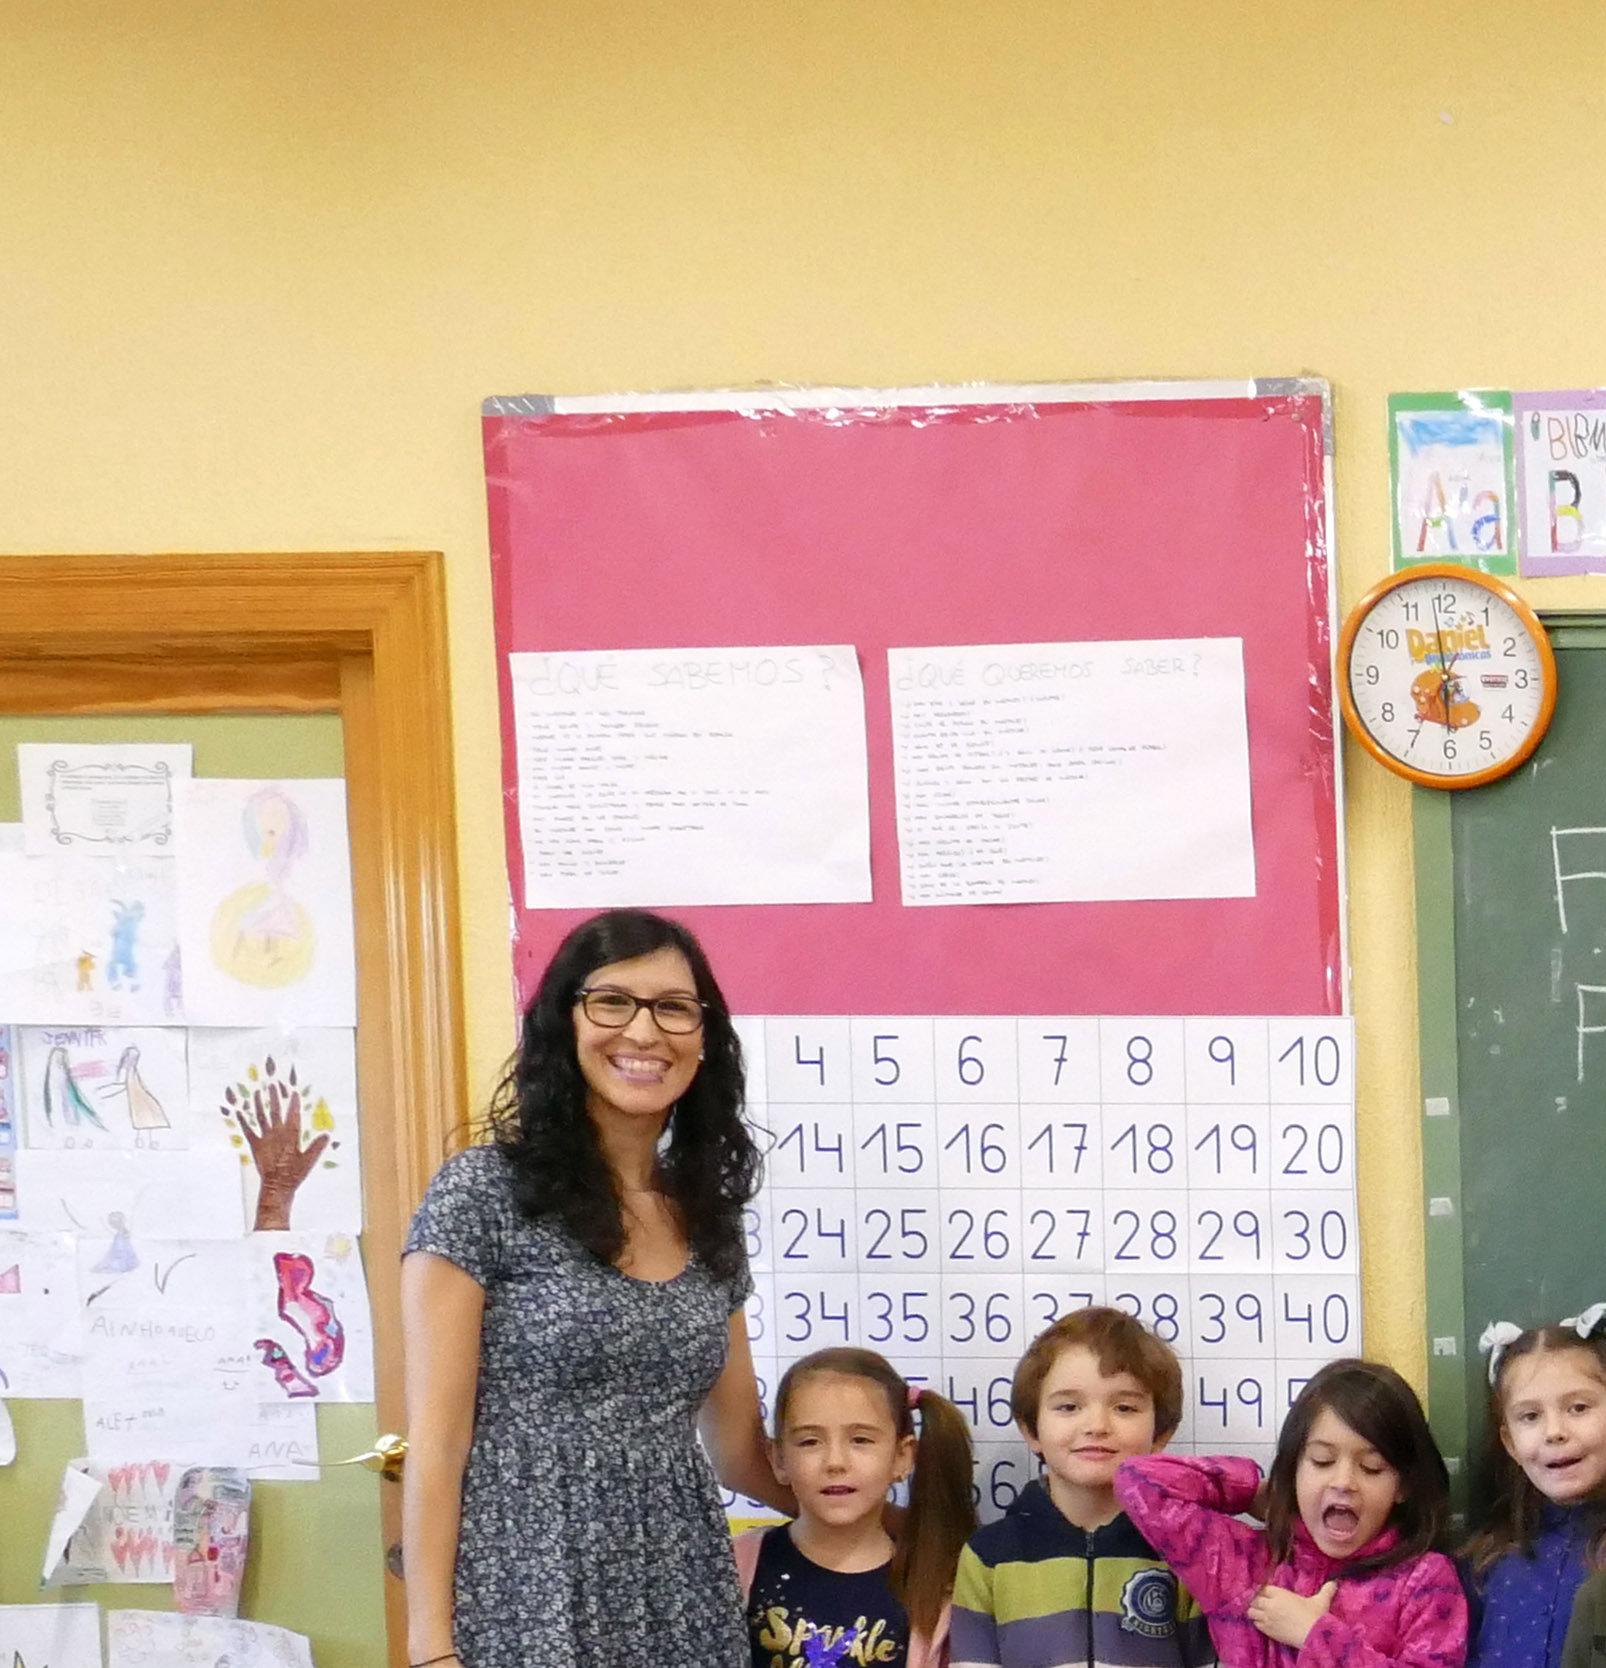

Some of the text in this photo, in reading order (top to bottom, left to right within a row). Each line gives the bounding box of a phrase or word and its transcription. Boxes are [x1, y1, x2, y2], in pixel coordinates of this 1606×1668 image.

[1402, 602, 1419, 622] 11
[1433, 594, 1457, 614] 12
[1482, 607, 1490, 627] 1
[1377, 628, 1400, 650] 10
[1406, 624, 1491, 663] Daniel
[1503, 637, 1517, 658] 2
[1366, 665, 1380, 686] 9
[1514, 669, 1529, 690] 3
[1381, 702, 1395, 723] 8
[1501, 704, 1515, 723] 4
[1407, 729, 1420, 749] 7
[1443, 739, 1457, 760] 6
[1479, 730, 1493, 750] 5
[795, 1034, 826, 1086] 4
[872, 1034, 901, 1086] 5
[957, 1034, 985, 1086] 6
[1042, 1034, 1068, 1086] 7
[1126, 1034, 1154, 1086] 8
[1208, 1034, 1237, 1086] 9
[1279, 1034, 1341, 1086] 10
[777, 1122, 844, 1174] 14
[861, 1122, 924, 1174] 15
[944, 1122, 1006, 1174] 16
[1027, 1122, 1088, 1174] 17
[1110, 1122, 1175, 1174] 18
[1194, 1122, 1257, 1174] 19
[1281, 1122, 1344, 1174] 20
[782, 1208, 847, 1260] 24
[865, 1208, 928, 1260] 25
[948, 1208, 1011, 1260] 26
[1029, 1208, 1091, 1260] 27
[1113, 1208, 1178, 1260] 28
[1197, 1208, 1262, 1260] 29
[1283, 1208, 1348, 1260] 30
[784, 1291, 850, 1344] 34
[867, 1291, 929, 1344] 35
[949, 1291, 1012, 1344] 36
[1199, 1291, 1264, 1344] 39
[1284, 1291, 1350, 1344] 40
[949, 1376, 1015, 1427] 46
[1200, 1377, 1264, 1428] 49
